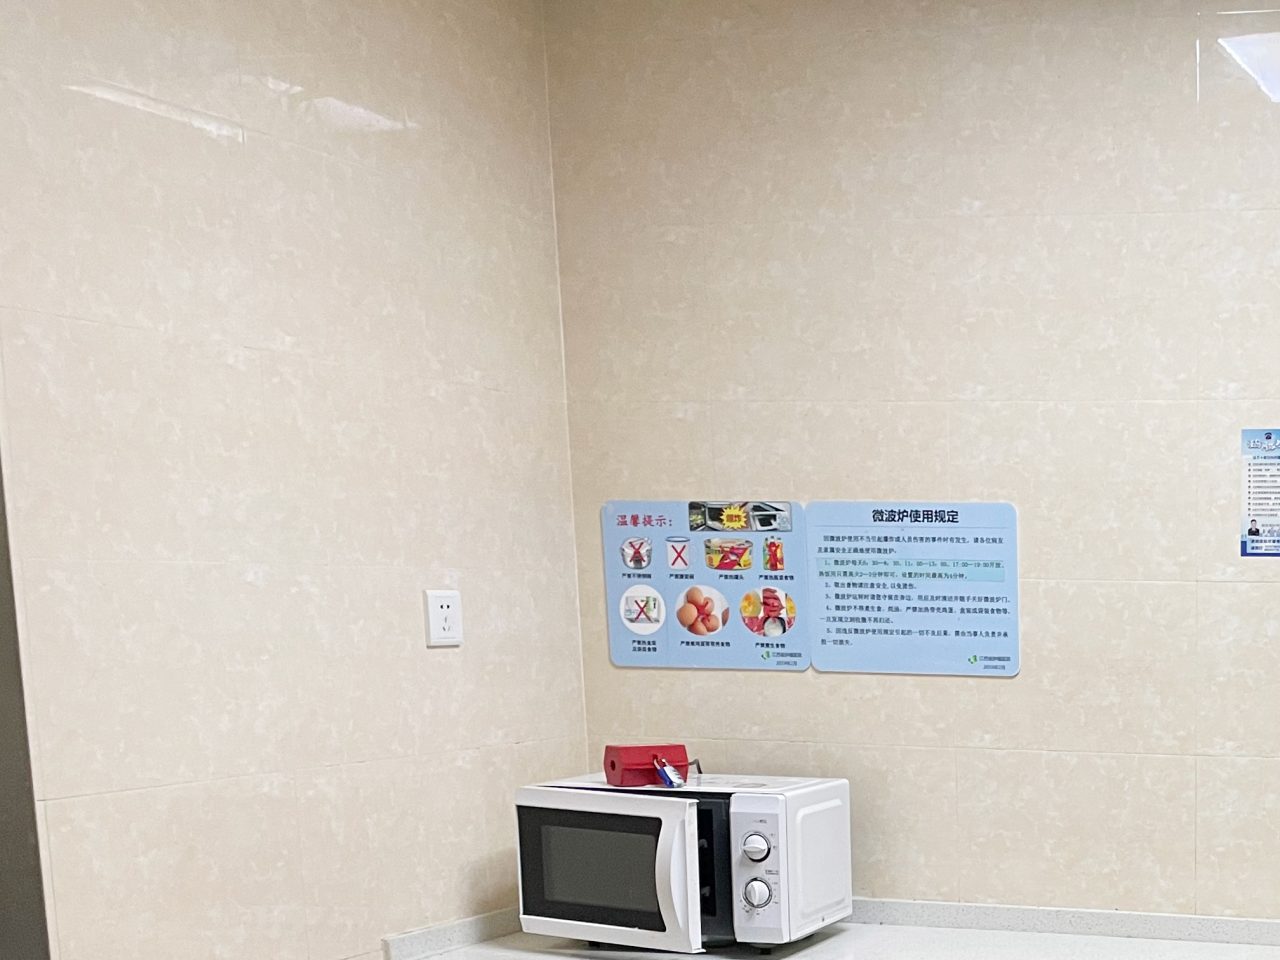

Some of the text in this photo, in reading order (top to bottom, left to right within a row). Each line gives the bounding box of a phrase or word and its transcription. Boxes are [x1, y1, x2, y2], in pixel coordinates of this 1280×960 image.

[872, 509, 960, 523] 微波炉使用规定
